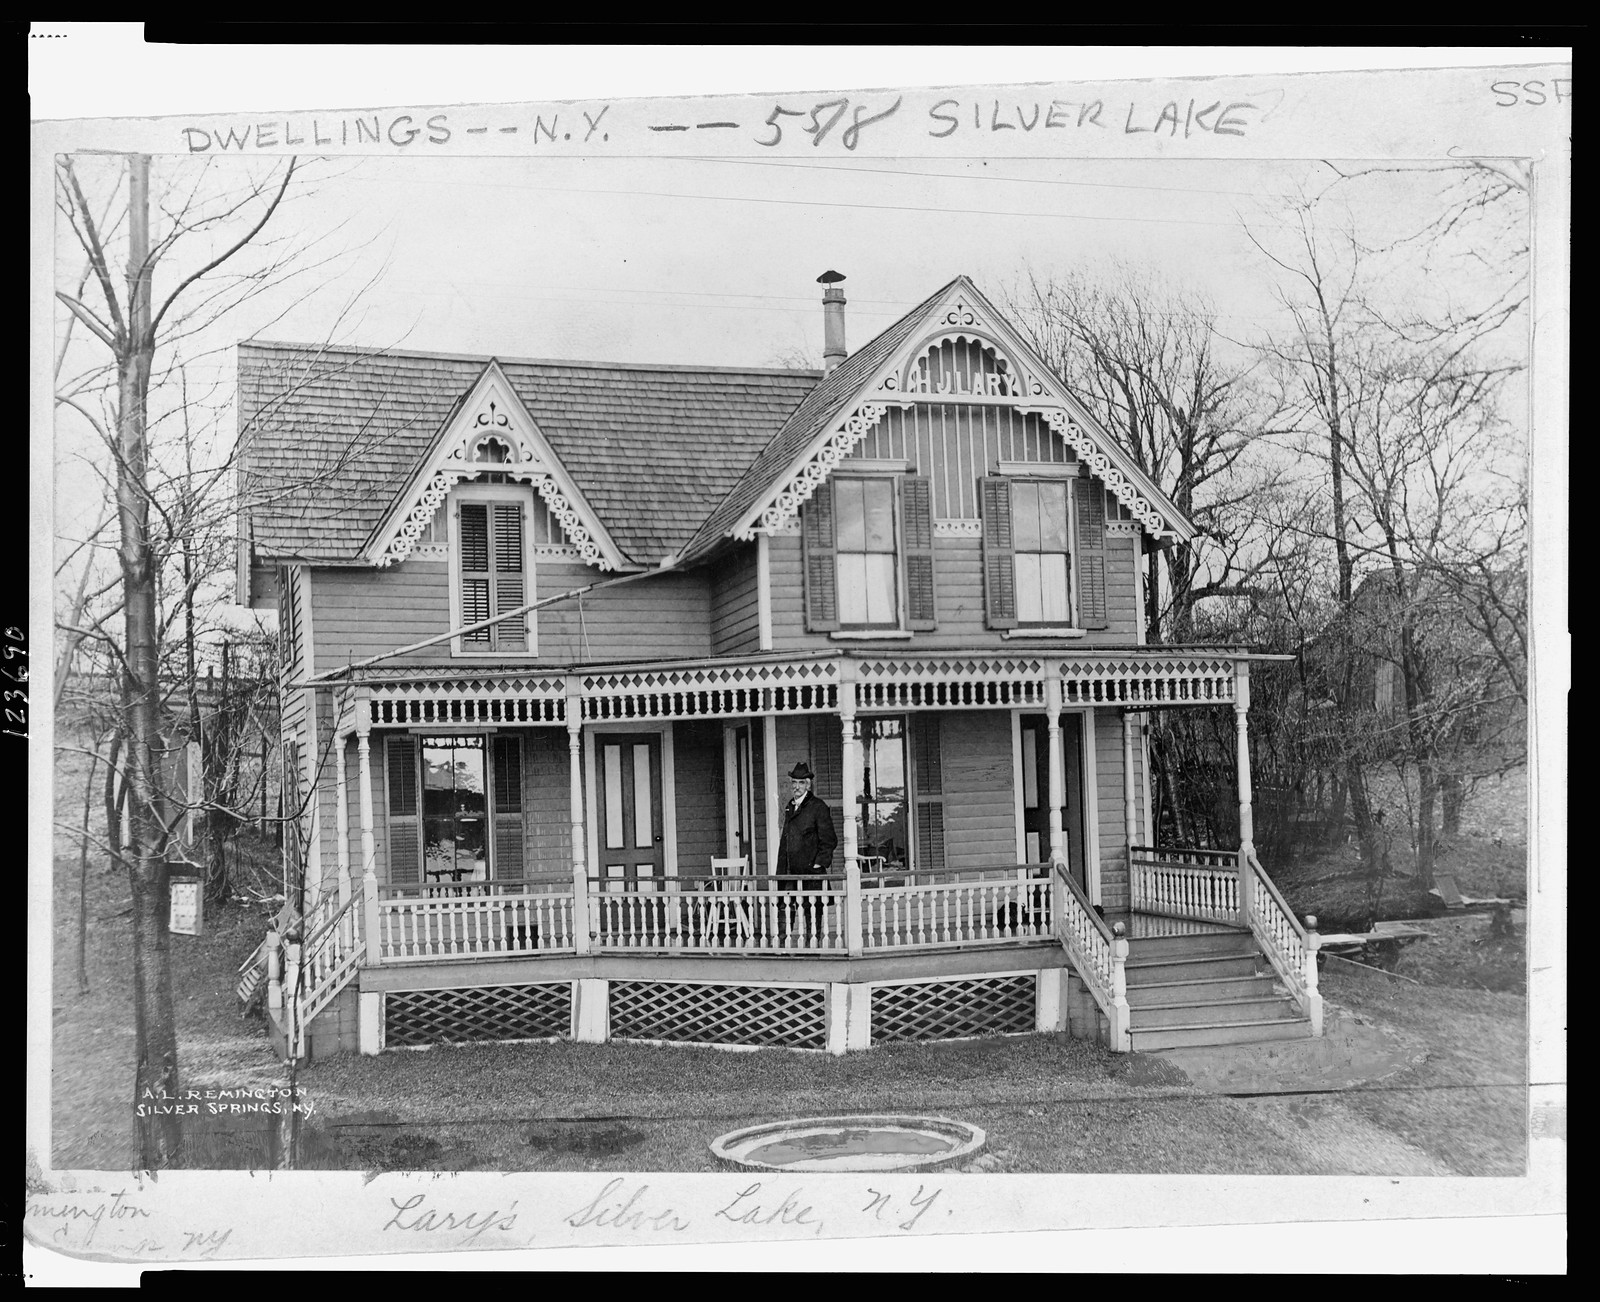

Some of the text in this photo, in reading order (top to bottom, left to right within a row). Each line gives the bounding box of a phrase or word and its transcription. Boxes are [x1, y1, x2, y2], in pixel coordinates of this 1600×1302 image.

[182, 115, 452, 152] DWELLINGS
[929, 99, 1104, 138] SILVER
[1124, 97, 1257, 138] LAKE
[564, 1177, 691, 1232] Silver
